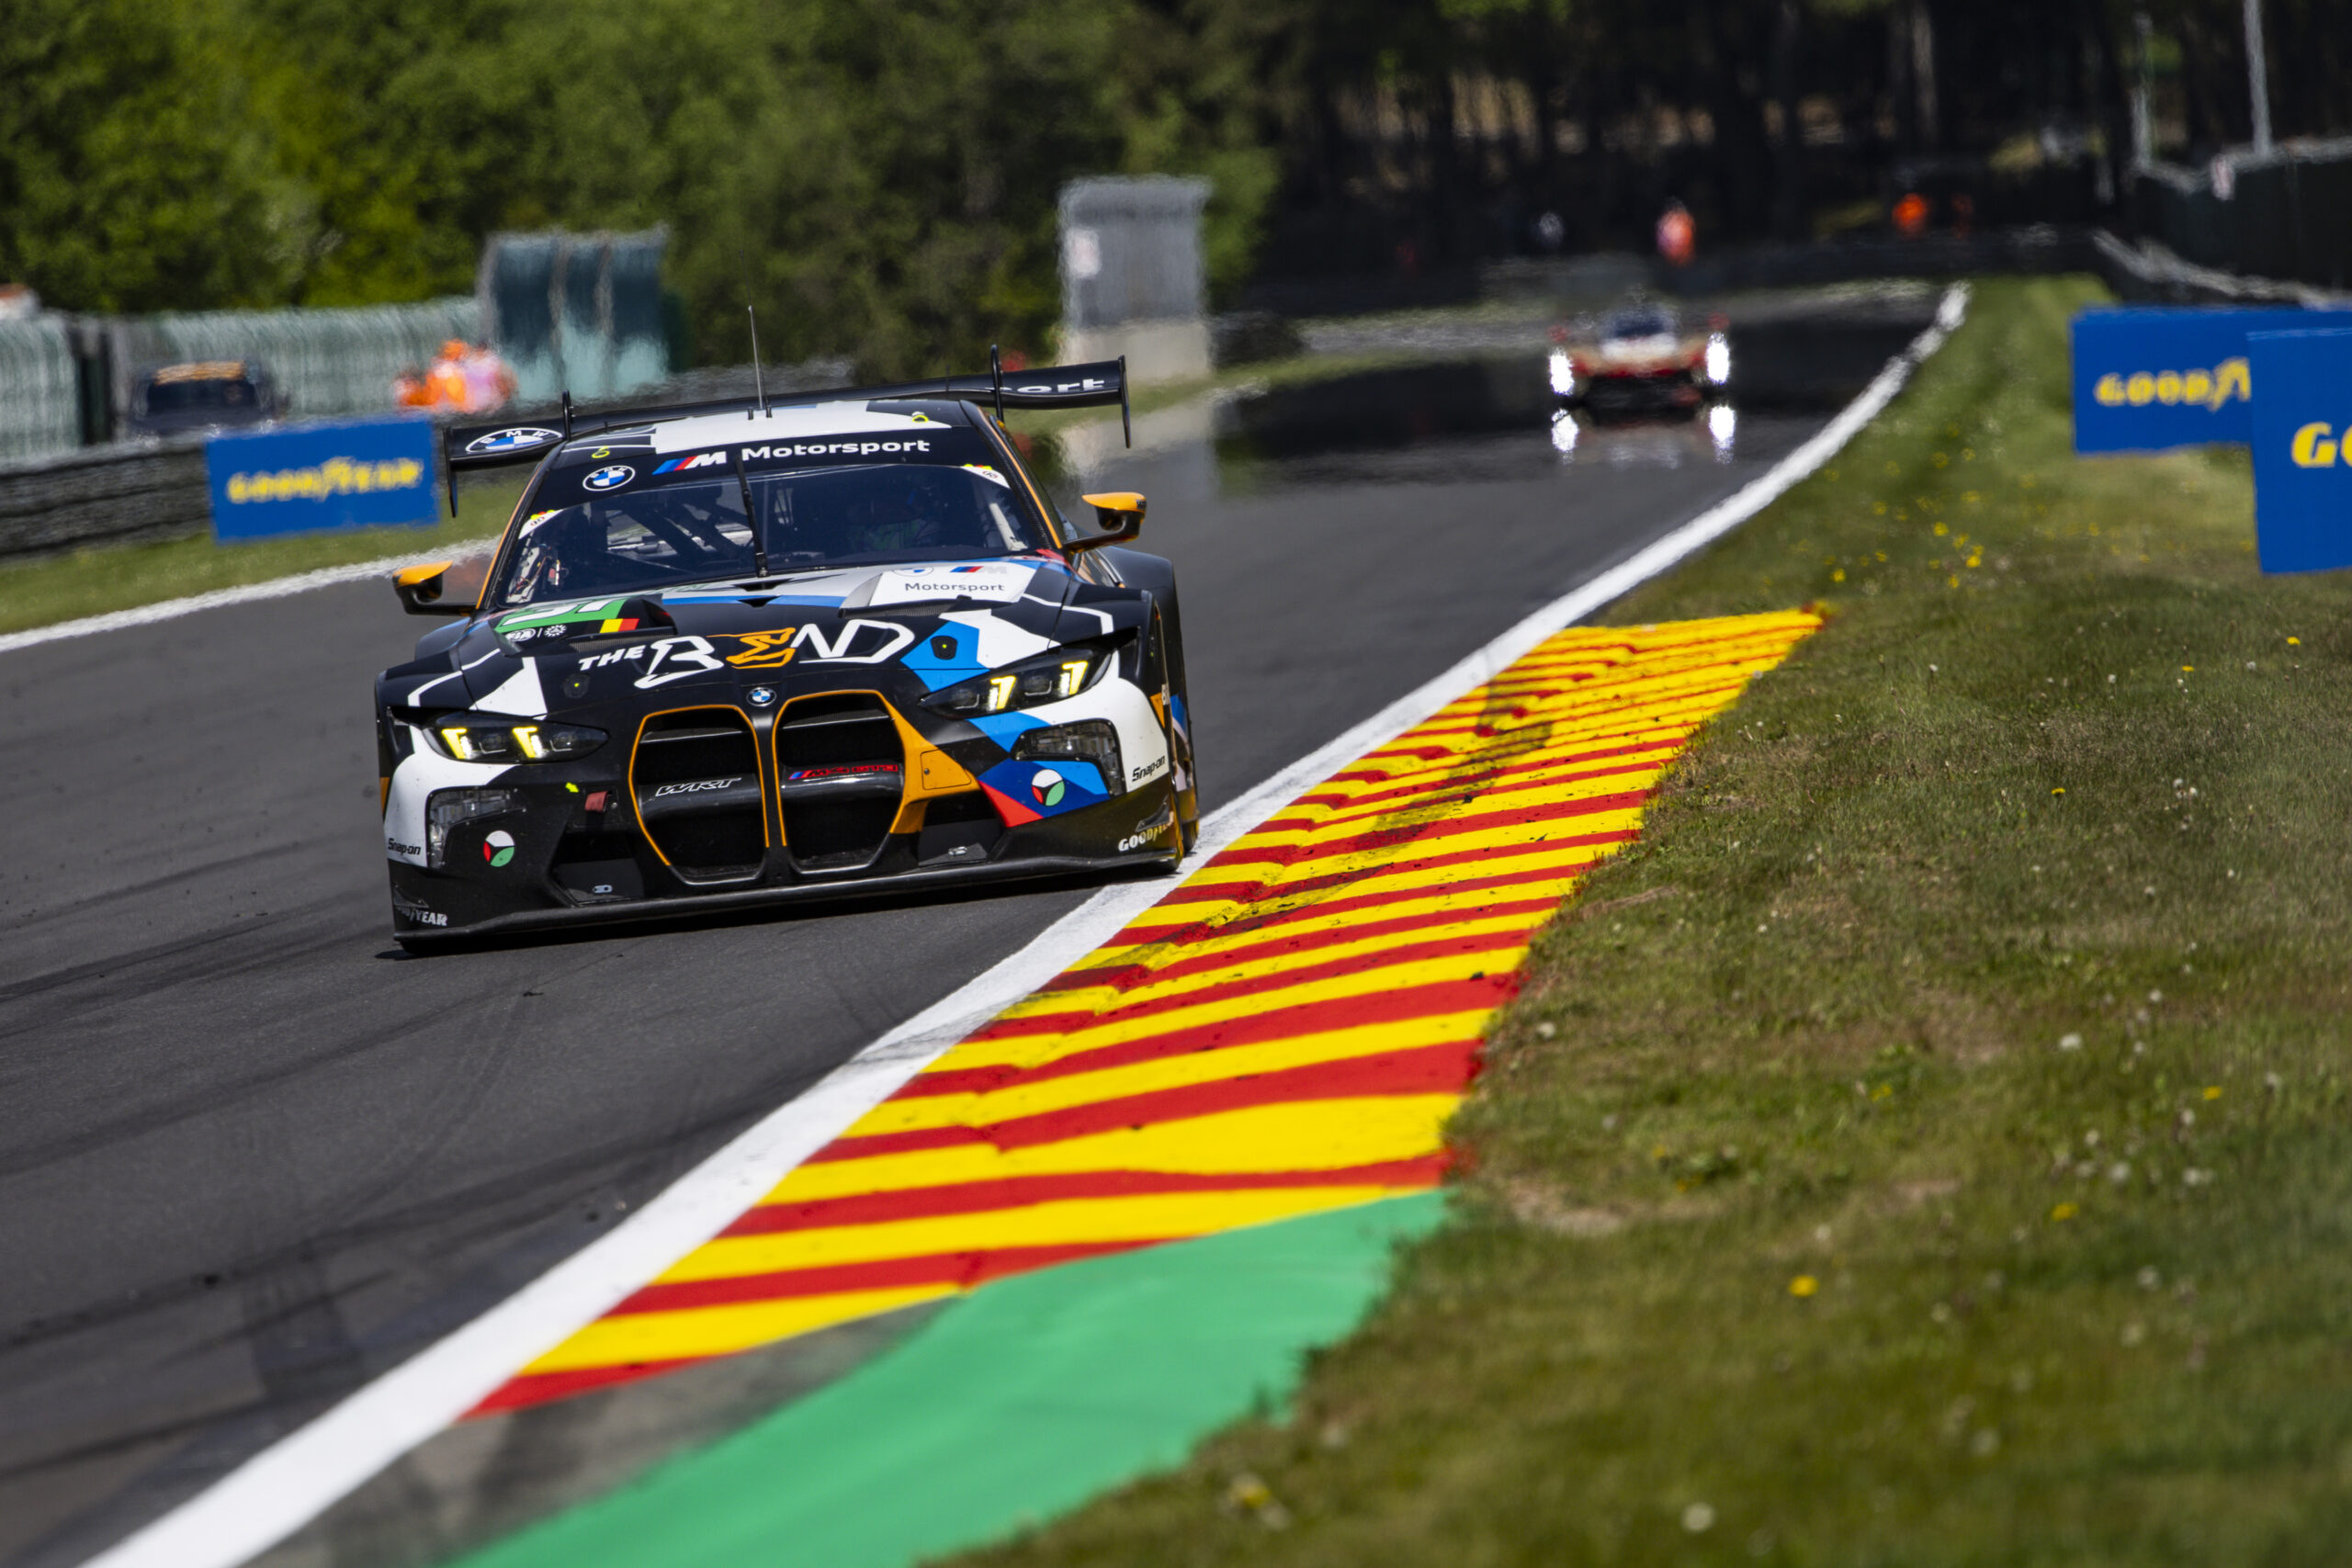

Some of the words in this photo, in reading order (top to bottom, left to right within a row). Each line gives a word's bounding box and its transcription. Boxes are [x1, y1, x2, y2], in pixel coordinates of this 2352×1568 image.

[480, 430, 550, 445] BMW
[741, 440, 930, 461] Motorsport
[905, 582, 1005, 592] Motorsport
[578, 645, 646, 671] THE
[1131, 755, 1166, 783] Snap-on
[655, 777, 741, 797] WRT
[388, 837, 422, 856] Snap-on
